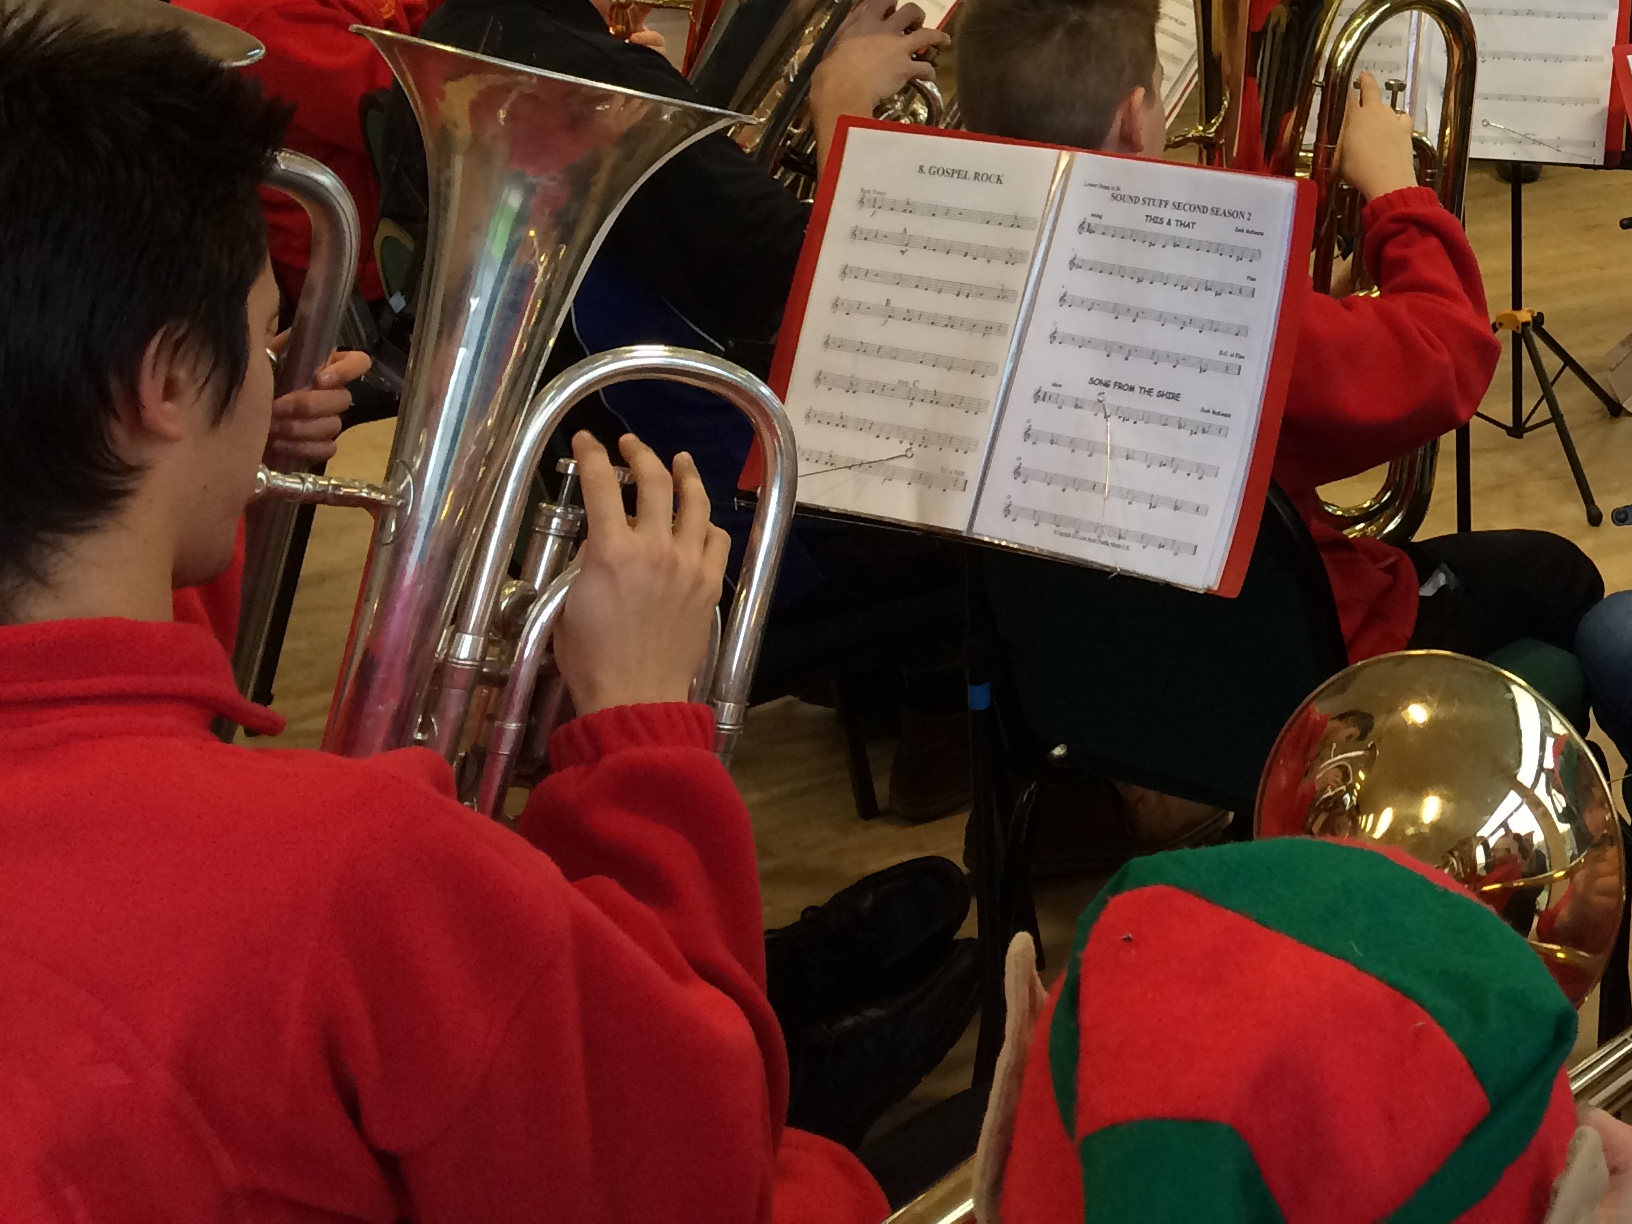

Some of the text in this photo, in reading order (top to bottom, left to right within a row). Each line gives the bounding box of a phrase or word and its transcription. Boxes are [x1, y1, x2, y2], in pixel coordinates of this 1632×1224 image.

[917, 164, 1004, 185] 8. GOSPEL ROCK
[1110, 192, 1140, 205] SOUND
[1141, 197, 1170, 210] STUFF
[1171, 201, 1209, 215] SECOND
[1209, 206, 1246, 220] SEASON
[1144, 214, 1164, 226] THIS
[1175, 219, 1197, 230] THAT
[1088, 377, 1182, 402] SONG FROM THE SHIRE
